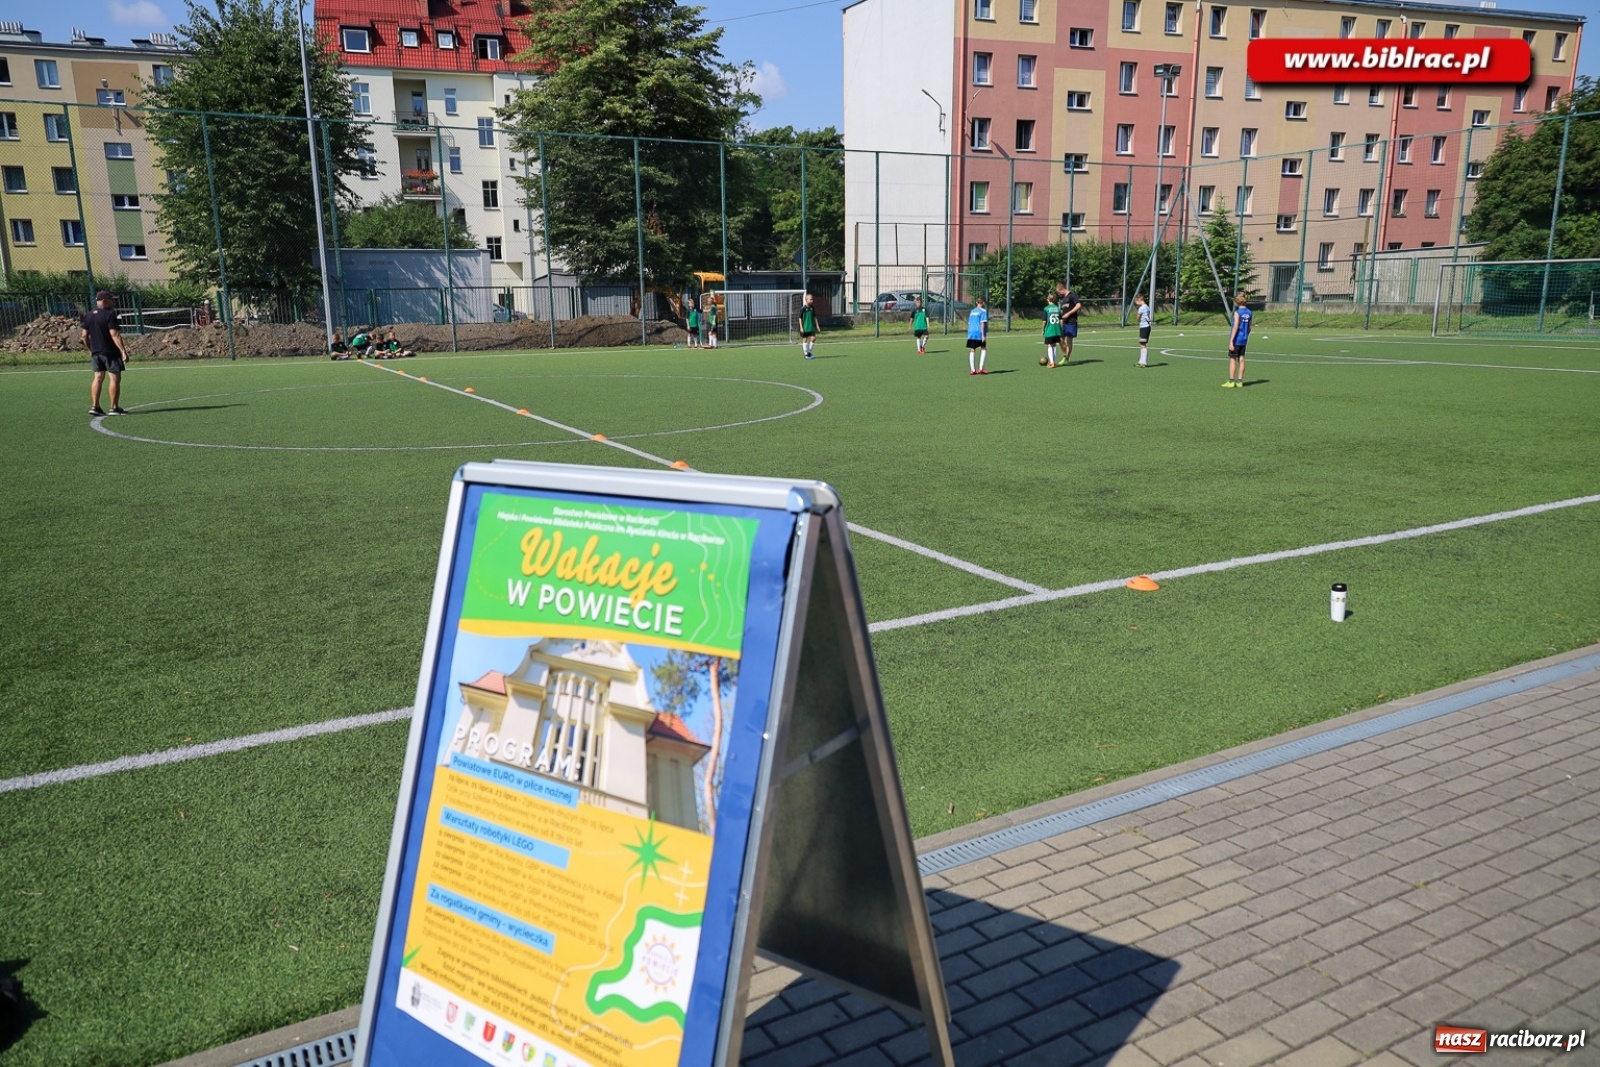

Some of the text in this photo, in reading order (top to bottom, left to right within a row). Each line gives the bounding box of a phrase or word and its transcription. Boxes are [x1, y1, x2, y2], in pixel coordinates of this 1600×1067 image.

[553, 506, 583, 519] Starostwo
[584, 510, 618, 522] Powiatowe
[626, 513, 659, 526] Raciborzu
[553, 516, 583, 529] Biblioteka
[584, 519, 613, 531] Publiczna
[687, 531, 725, 546] Raciborzu
[521, 527, 678, 609] Wakacje
[507, 578, 684, 636] W POWIECIE
[453, 723, 582, 782] PROGRAM:
[452, 756, 572, 804] Powiatowe EURO w piłce nożnej
[444, 811, 479, 834] Warsztaty
[480, 822, 511, 844] robotyki
[512, 835, 534, 851] LEGO
[430, 887, 440, 900] Za
[440, 891, 477, 916] rogatkami
[477, 910, 501, 930] gminy
[507, 922, 549, 947] wycieczka
